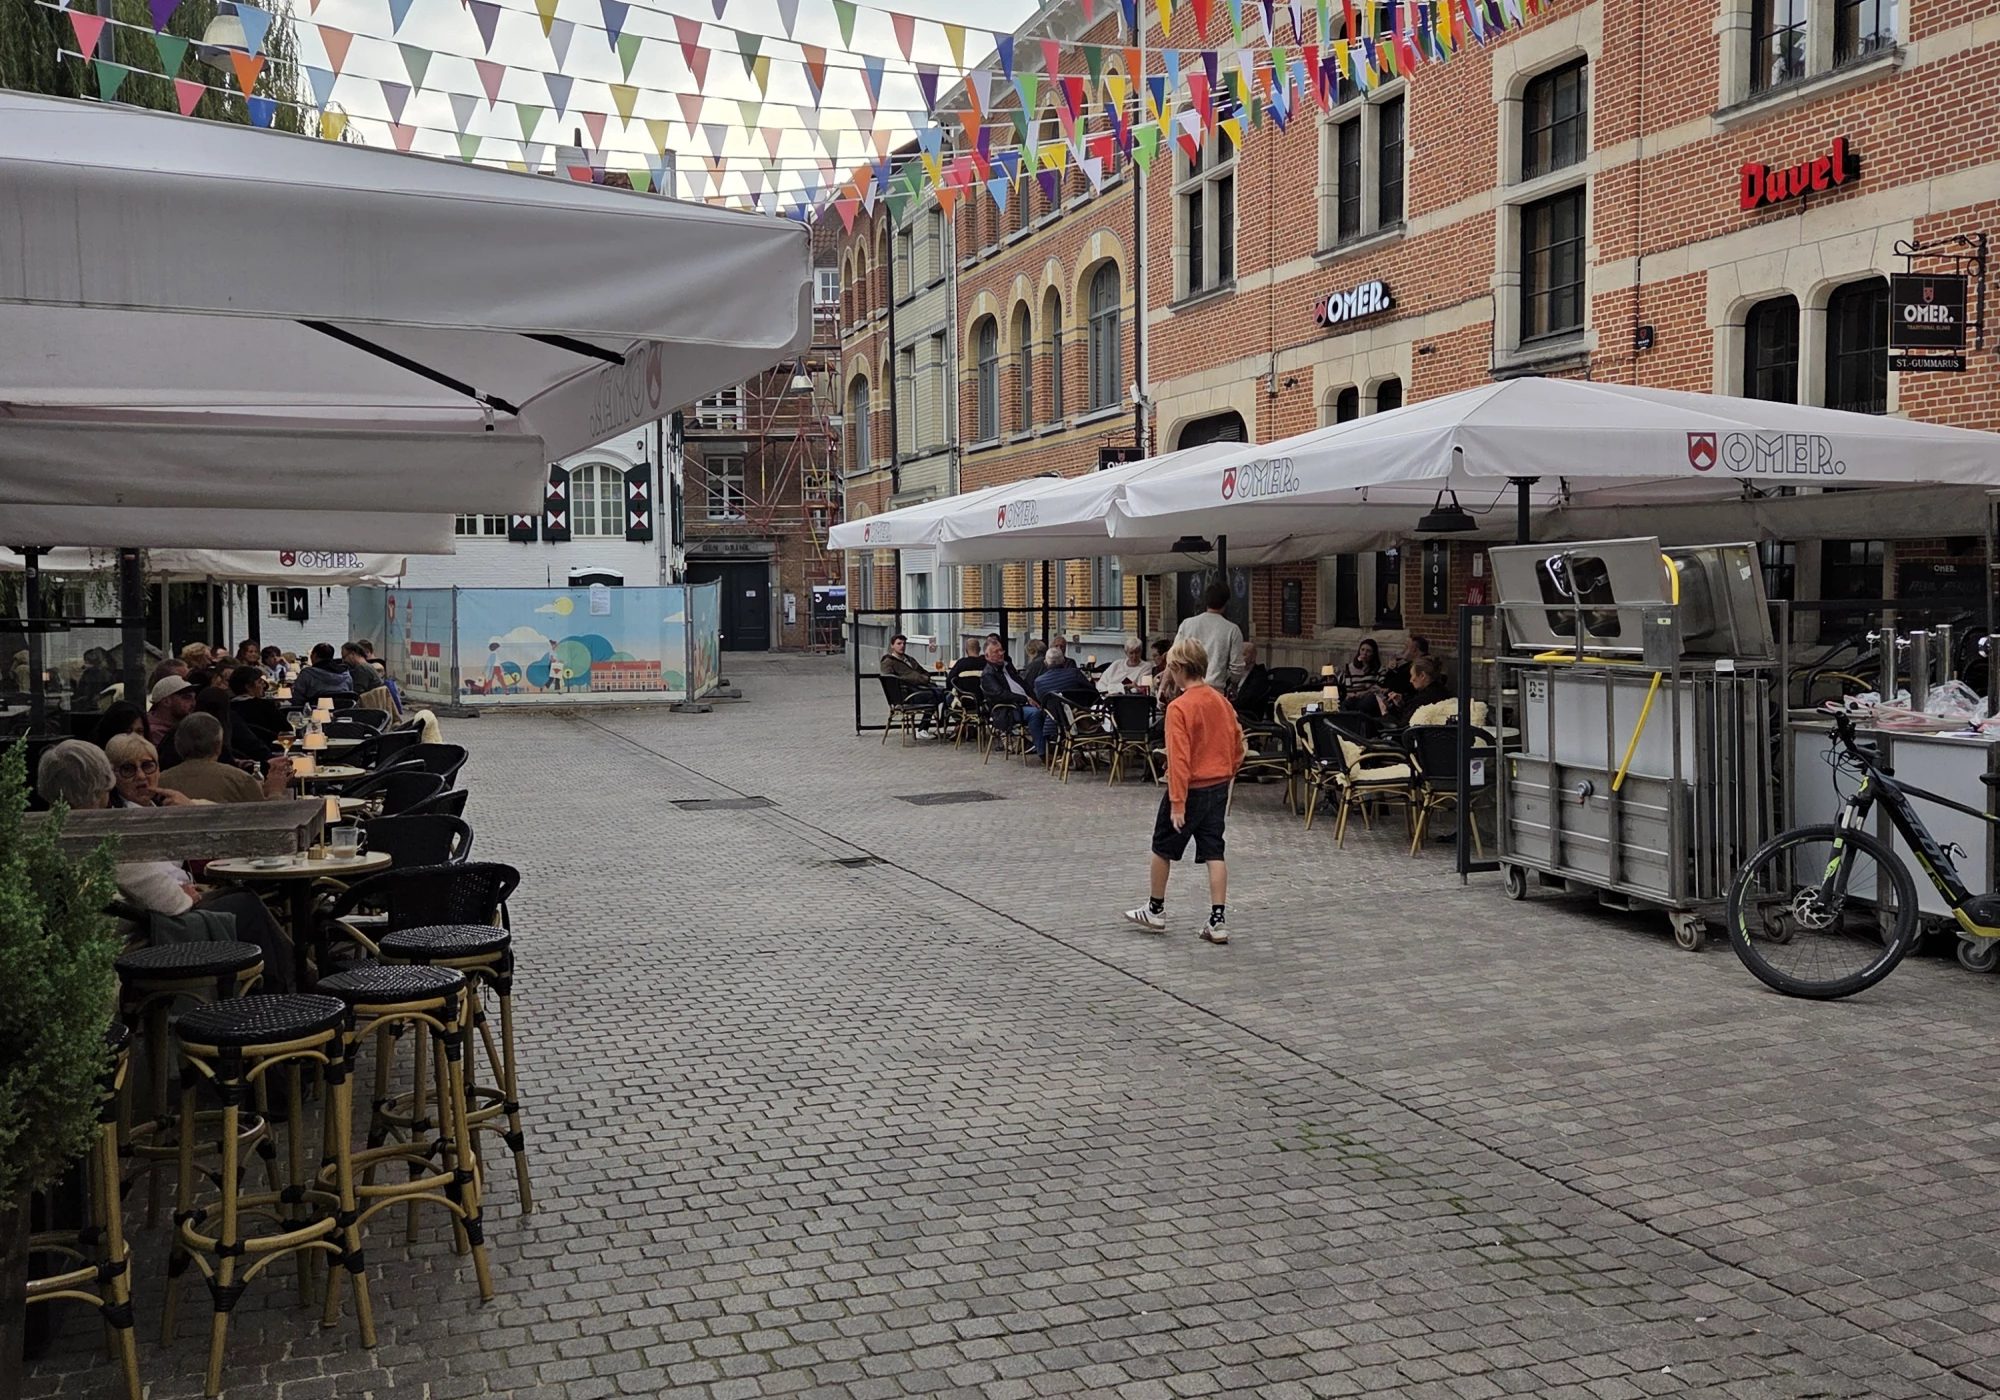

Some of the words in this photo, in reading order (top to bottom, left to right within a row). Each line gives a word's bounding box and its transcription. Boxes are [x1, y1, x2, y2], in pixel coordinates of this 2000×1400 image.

[1740, 136, 1846, 211] Duvel
[1327, 280, 1390, 323] OMER.
[1903, 304, 1955, 323] OMER.
[1721, 432, 1847, 475] OMER.
[1236, 457, 1300, 498] OMER.
[299, 551, 365, 569] OMER.
[1467, 587, 1484, 606] illy
